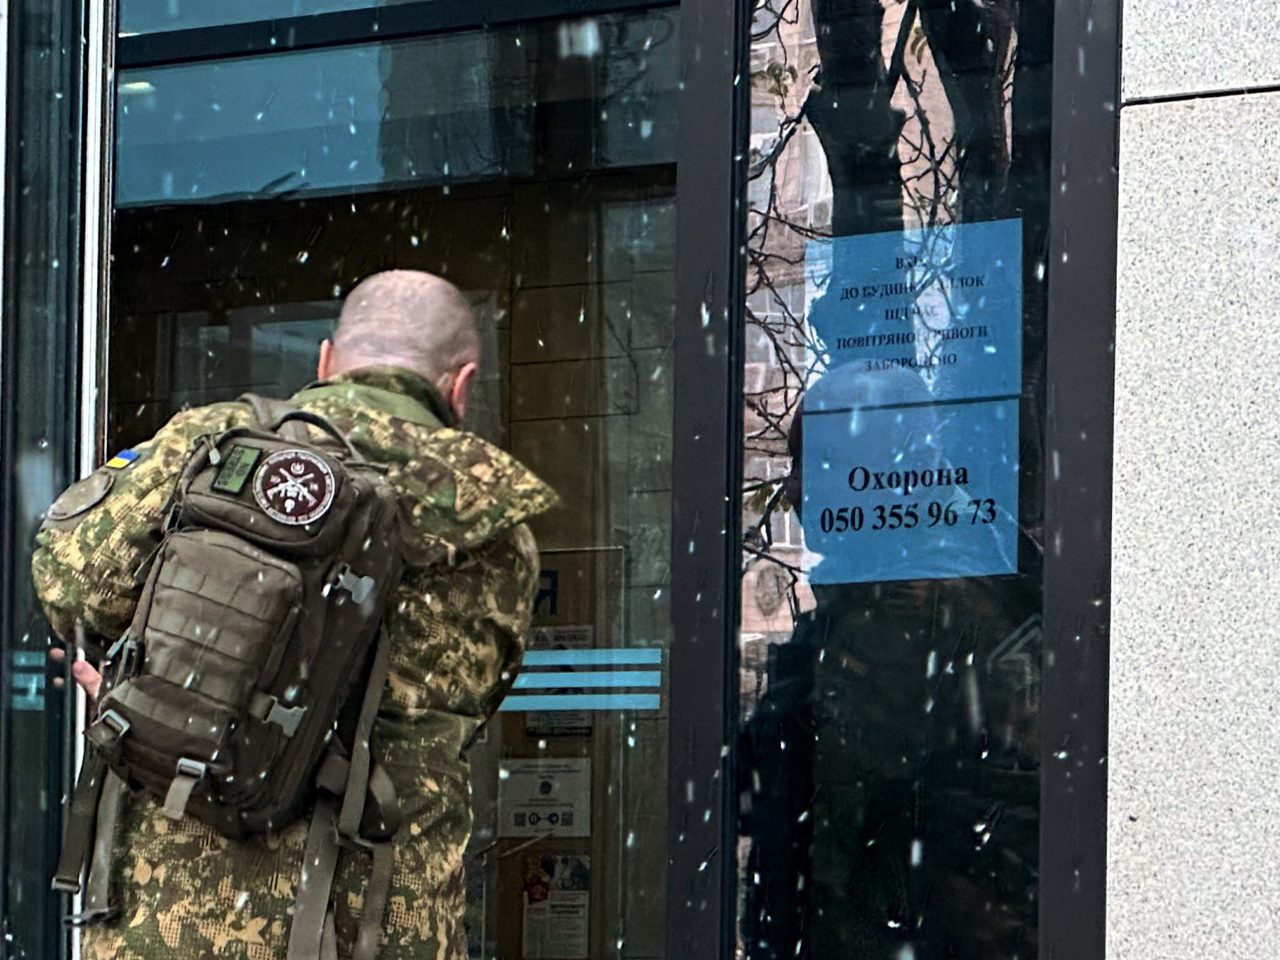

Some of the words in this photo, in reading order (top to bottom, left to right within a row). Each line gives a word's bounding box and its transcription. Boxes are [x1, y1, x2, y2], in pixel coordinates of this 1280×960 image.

[840, 285, 859, 301] ДО
[861, 279, 923, 299] БУДИНК
[836, 332, 919, 350] ПОВІТРЯНО
[848, 465, 969, 495] Охорона
[820, 506, 864, 533] 050
[872, 503, 919, 531] 355
[927, 501, 959, 527] 96
[968, 498, 997, 526] 73
